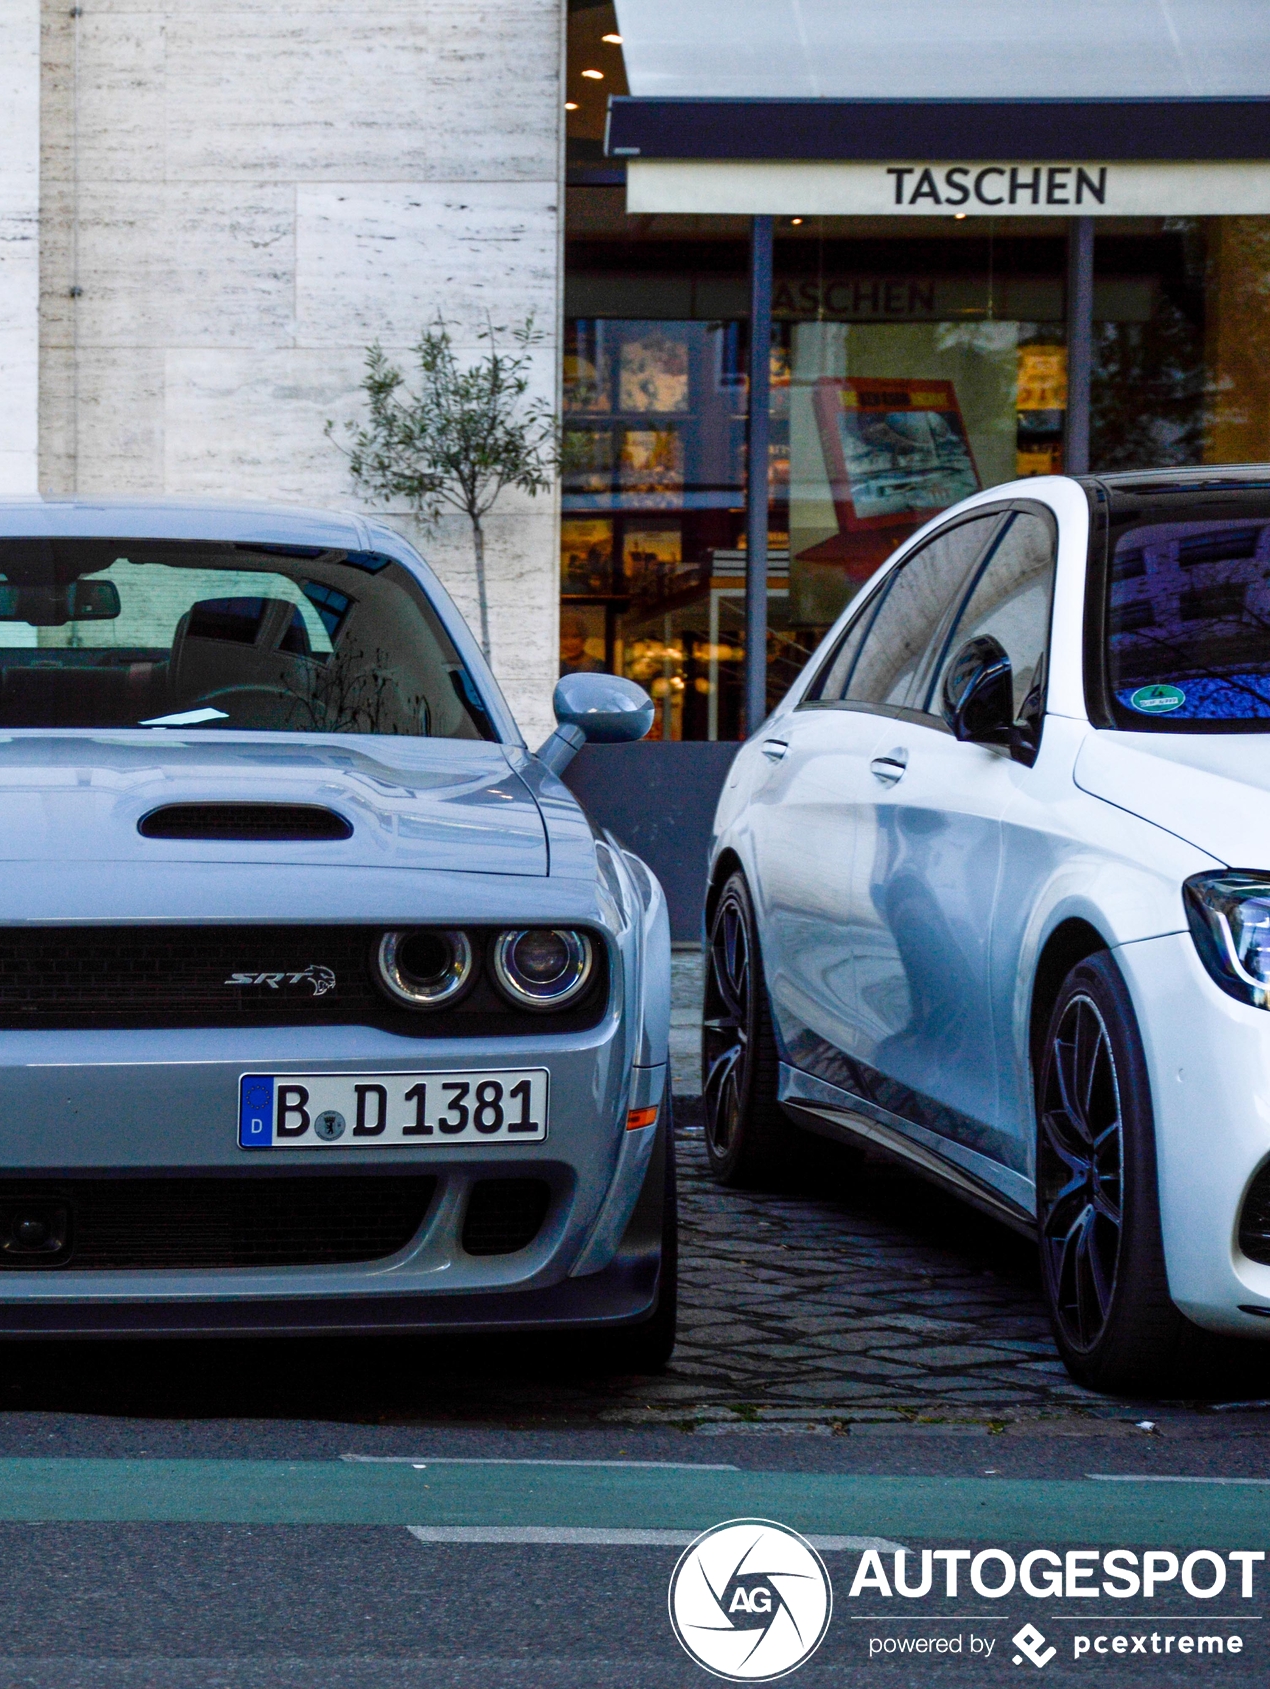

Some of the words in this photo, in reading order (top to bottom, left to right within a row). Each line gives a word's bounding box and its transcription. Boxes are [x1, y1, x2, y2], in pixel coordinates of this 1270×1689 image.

[886, 166, 1108, 206] TASCHEN
[773, 280, 936, 313] ASCHEN
[224, 972, 314, 989] SRT
[251, 1118, 263, 1134] D
[276, 1084, 311, 1138] B
[352, 1083, 389, 1136] D
[402, 1079, 540, 1135] 1381
